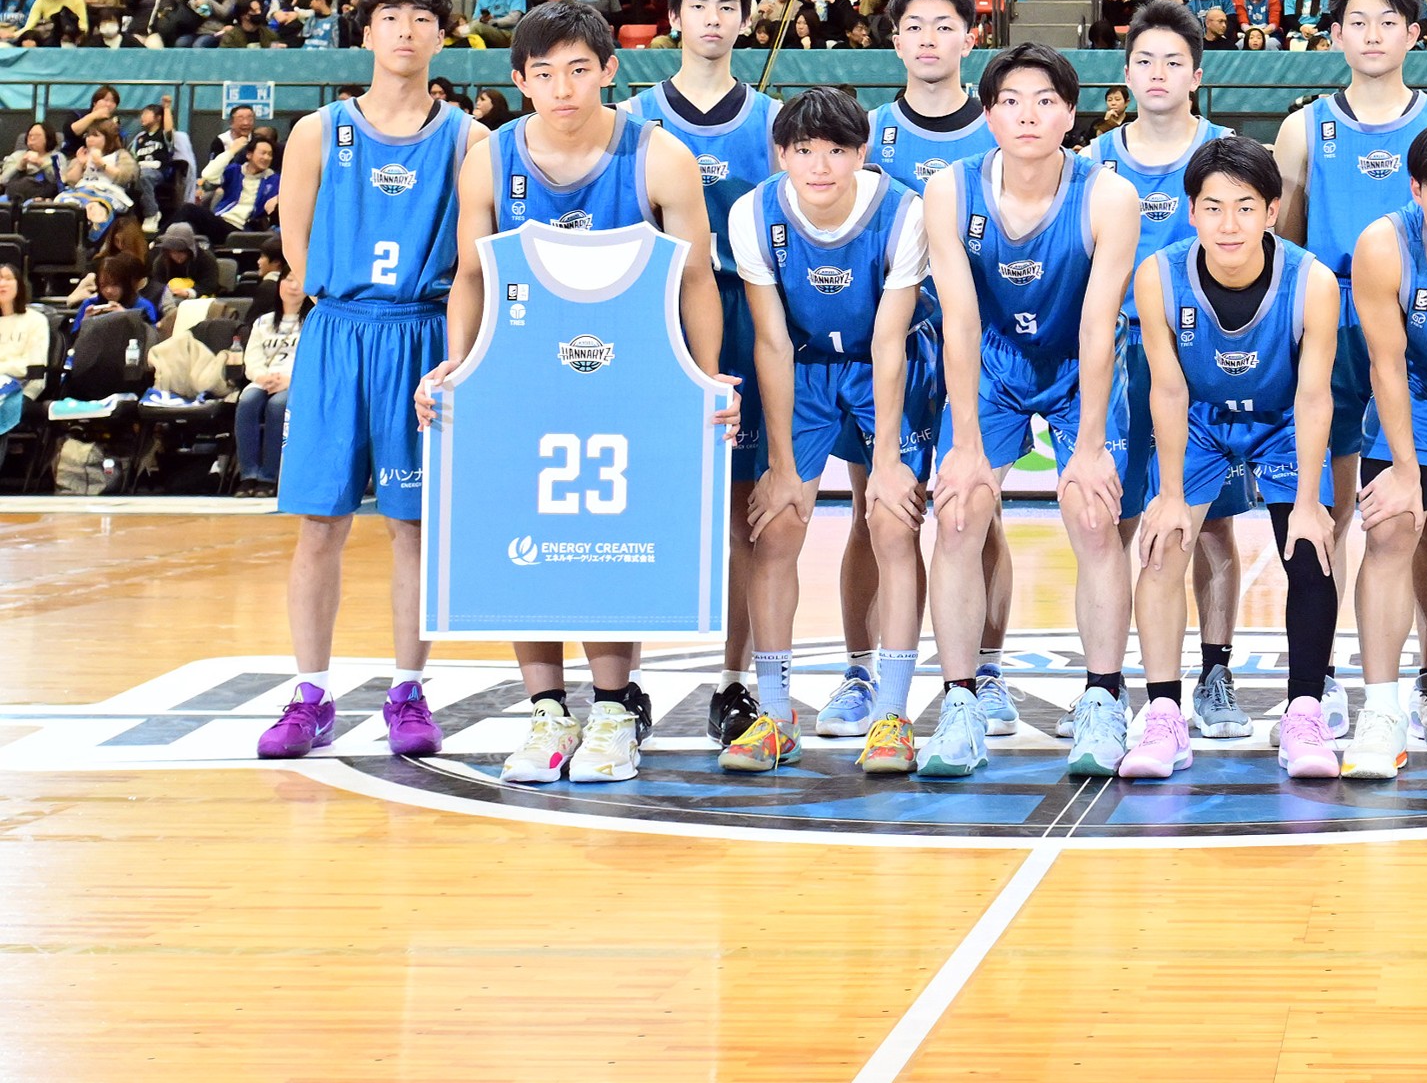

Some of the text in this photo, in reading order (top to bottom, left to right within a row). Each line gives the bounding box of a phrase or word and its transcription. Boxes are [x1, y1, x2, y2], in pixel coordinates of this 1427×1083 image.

[372, 171, 415, 186] HANNARYZ
[371, 241, 400, 285] 2
[1001, 263, 1044, 278] HANNARYZ
[810, 271, 851, 285] HANNARYZ
[828, 331, 844, 353] 1
[561, 346, 613, 362] HANNARYZ
[538, 433, 629, 514] 23
[541, 542, 656, 554] ENERGY CREATIVE
